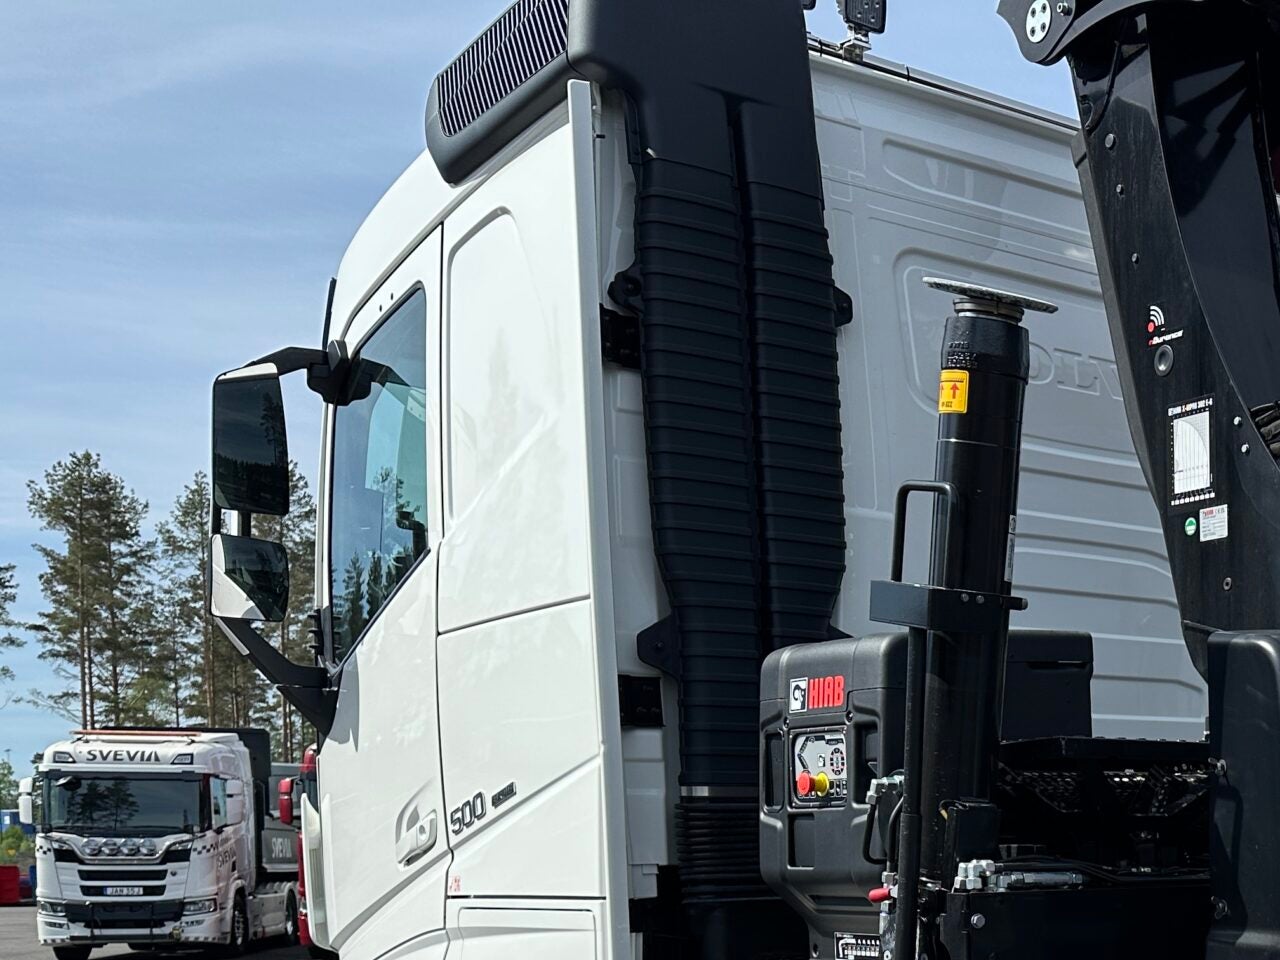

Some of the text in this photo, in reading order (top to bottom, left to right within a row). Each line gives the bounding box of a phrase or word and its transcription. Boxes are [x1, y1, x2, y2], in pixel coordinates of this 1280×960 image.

[809, 676, 845, 709] HIAB
[86, 749, 161, 762] SVEVIA
[451, 792, 486, 836] 500
